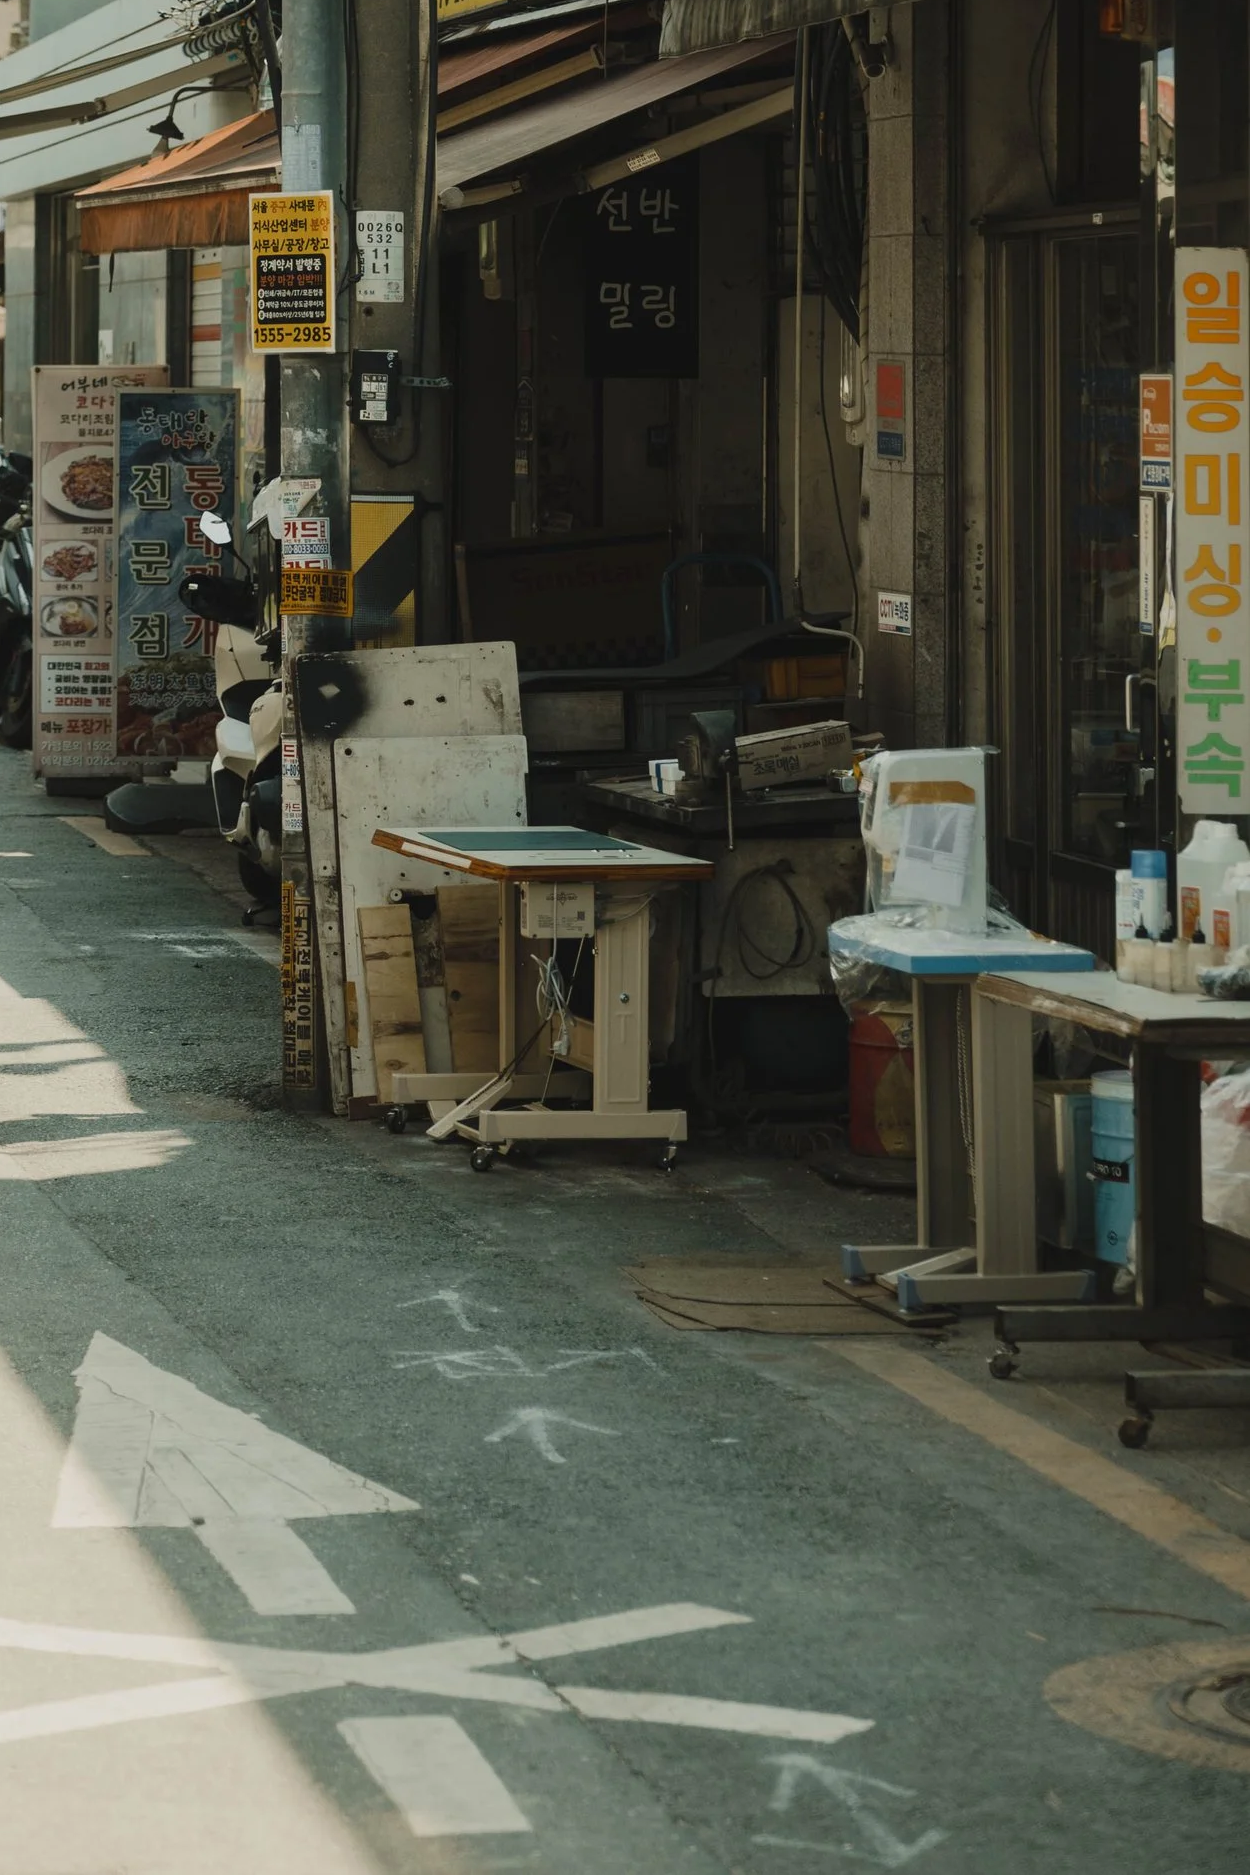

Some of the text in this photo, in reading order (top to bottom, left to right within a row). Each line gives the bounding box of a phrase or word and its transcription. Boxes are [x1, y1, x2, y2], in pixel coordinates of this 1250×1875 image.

[253, 218, 308, 234] 지식산업센터
[358, 222, 403, 233] 0026Q
[367, 234, 393, 244] 532
[599, 281, 678, 331] 밀링
[254, 326, 332, 344] 1555-2985
[61, 375, 108, 393] 어부네
[129, 462, 225, 660] 동태개 전문점
[66, 719, 112, 735] 포장가
